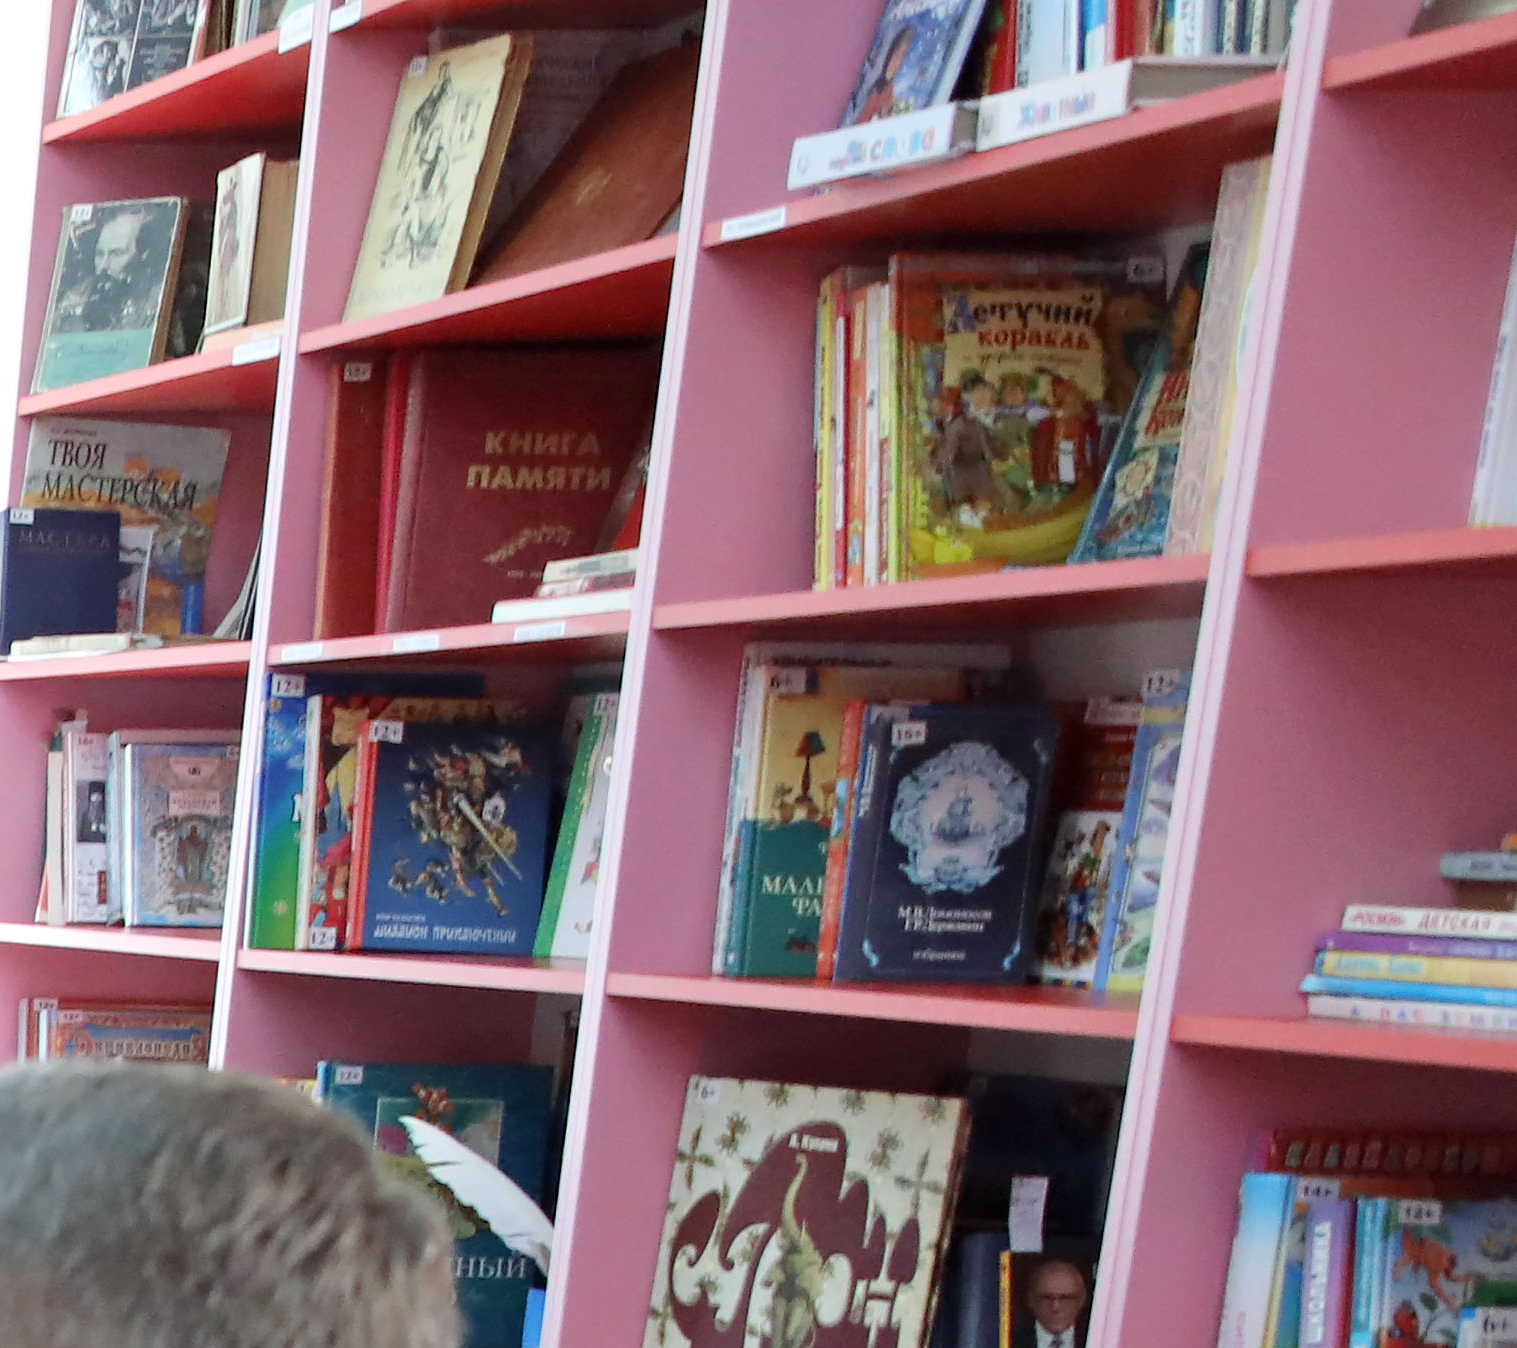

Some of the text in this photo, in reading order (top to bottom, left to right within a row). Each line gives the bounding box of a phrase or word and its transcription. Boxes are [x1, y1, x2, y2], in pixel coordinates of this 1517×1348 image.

[48, 438, 108, 470] ТВОЯ
[484, 431, 600, 455] КНИГА
[465, 464, 611, 490] ПАМЯТИ
[41, 472, 199, 511] МАСТЕРСКАЯ
[18, 529, 111, 549] МАСТЕРА
[275, 678, 304, 694] 12+
[373, 724, 400, 738] 12+
[454, 1256, 527, 1280] НЫЙ
